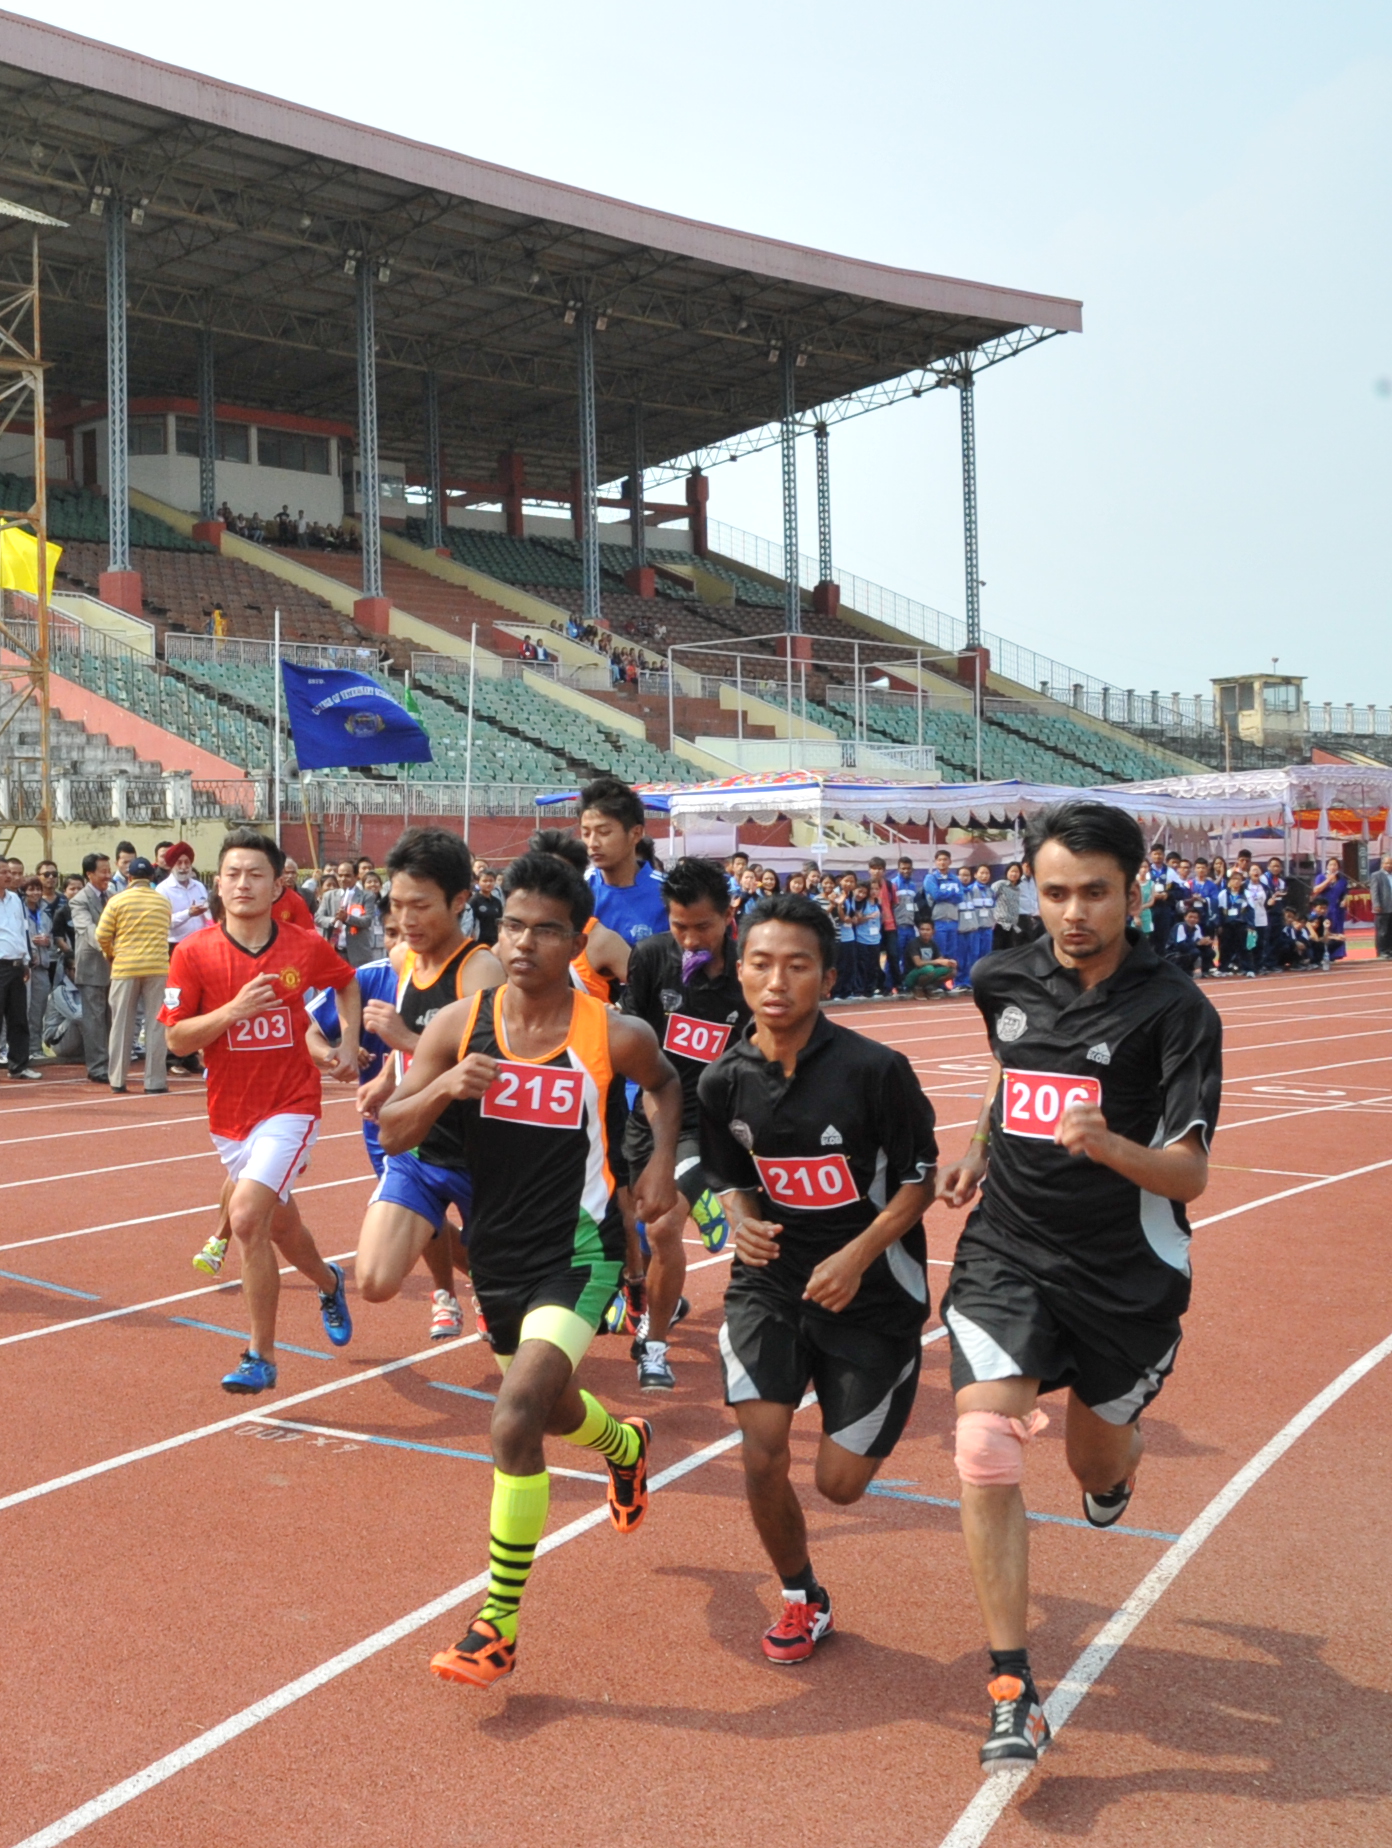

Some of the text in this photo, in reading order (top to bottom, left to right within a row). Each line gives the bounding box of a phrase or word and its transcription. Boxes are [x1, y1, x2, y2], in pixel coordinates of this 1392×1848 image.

[236, 1015, 286, 1042] 203
[673, 1022, 724, 1054] 207
[494, 1072, 575, 1114] 215
[768, 1165, 843, 1196] 210
